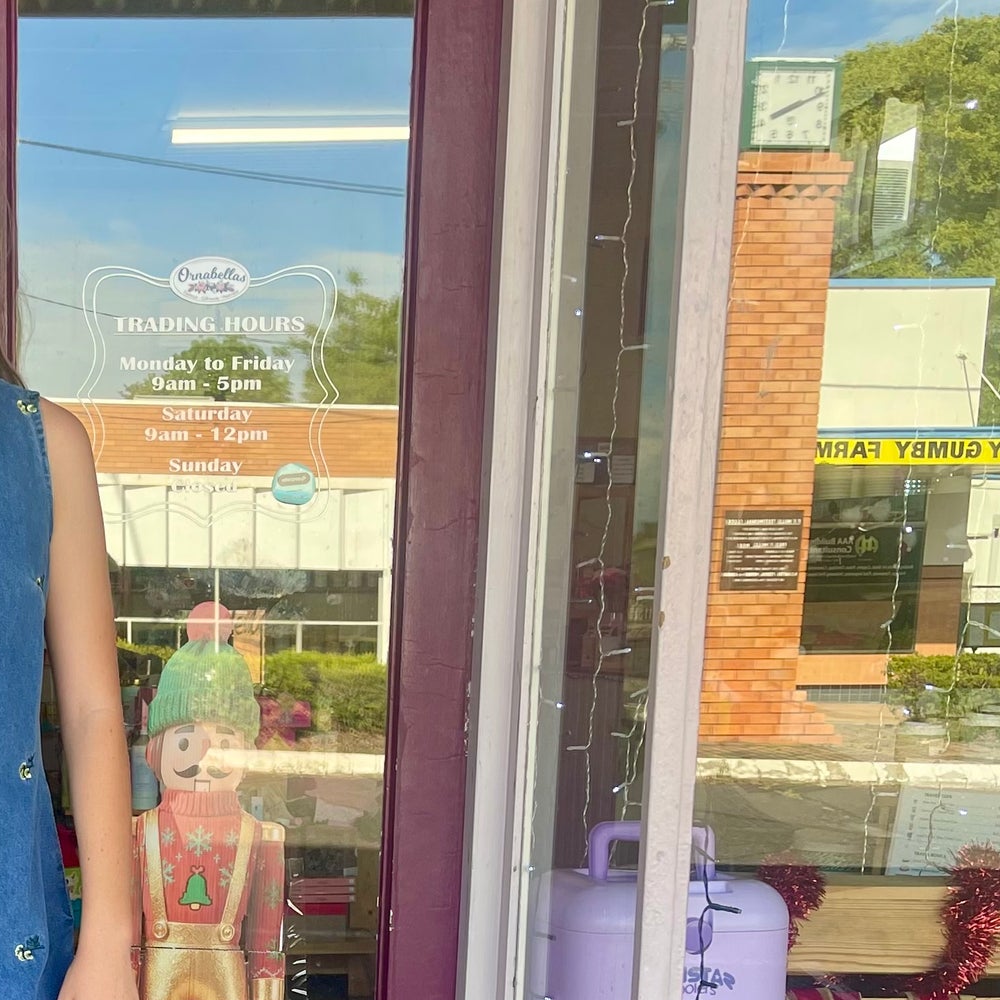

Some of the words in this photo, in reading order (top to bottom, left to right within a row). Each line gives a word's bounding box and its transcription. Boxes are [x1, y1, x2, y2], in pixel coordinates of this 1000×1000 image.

[178, 266, 246, 283] Ornabellas
[114, 316, 216, 332] TRADING
[224, 316, 305, 332] HOURS
[120, 356, 198, 373] Monday
[204, 358, 224, 371] to
[232, 356, 295, 373] Friday
[152, 376, 196, 391] 9am
[217, 376, 262, 393] 5pm
[162, 406, 252, 423] Saturday
[144, 427, 189, 441] 9am
[211, 427, 268, 444] 12pm
[169, 458, 243, 475] Sunday
